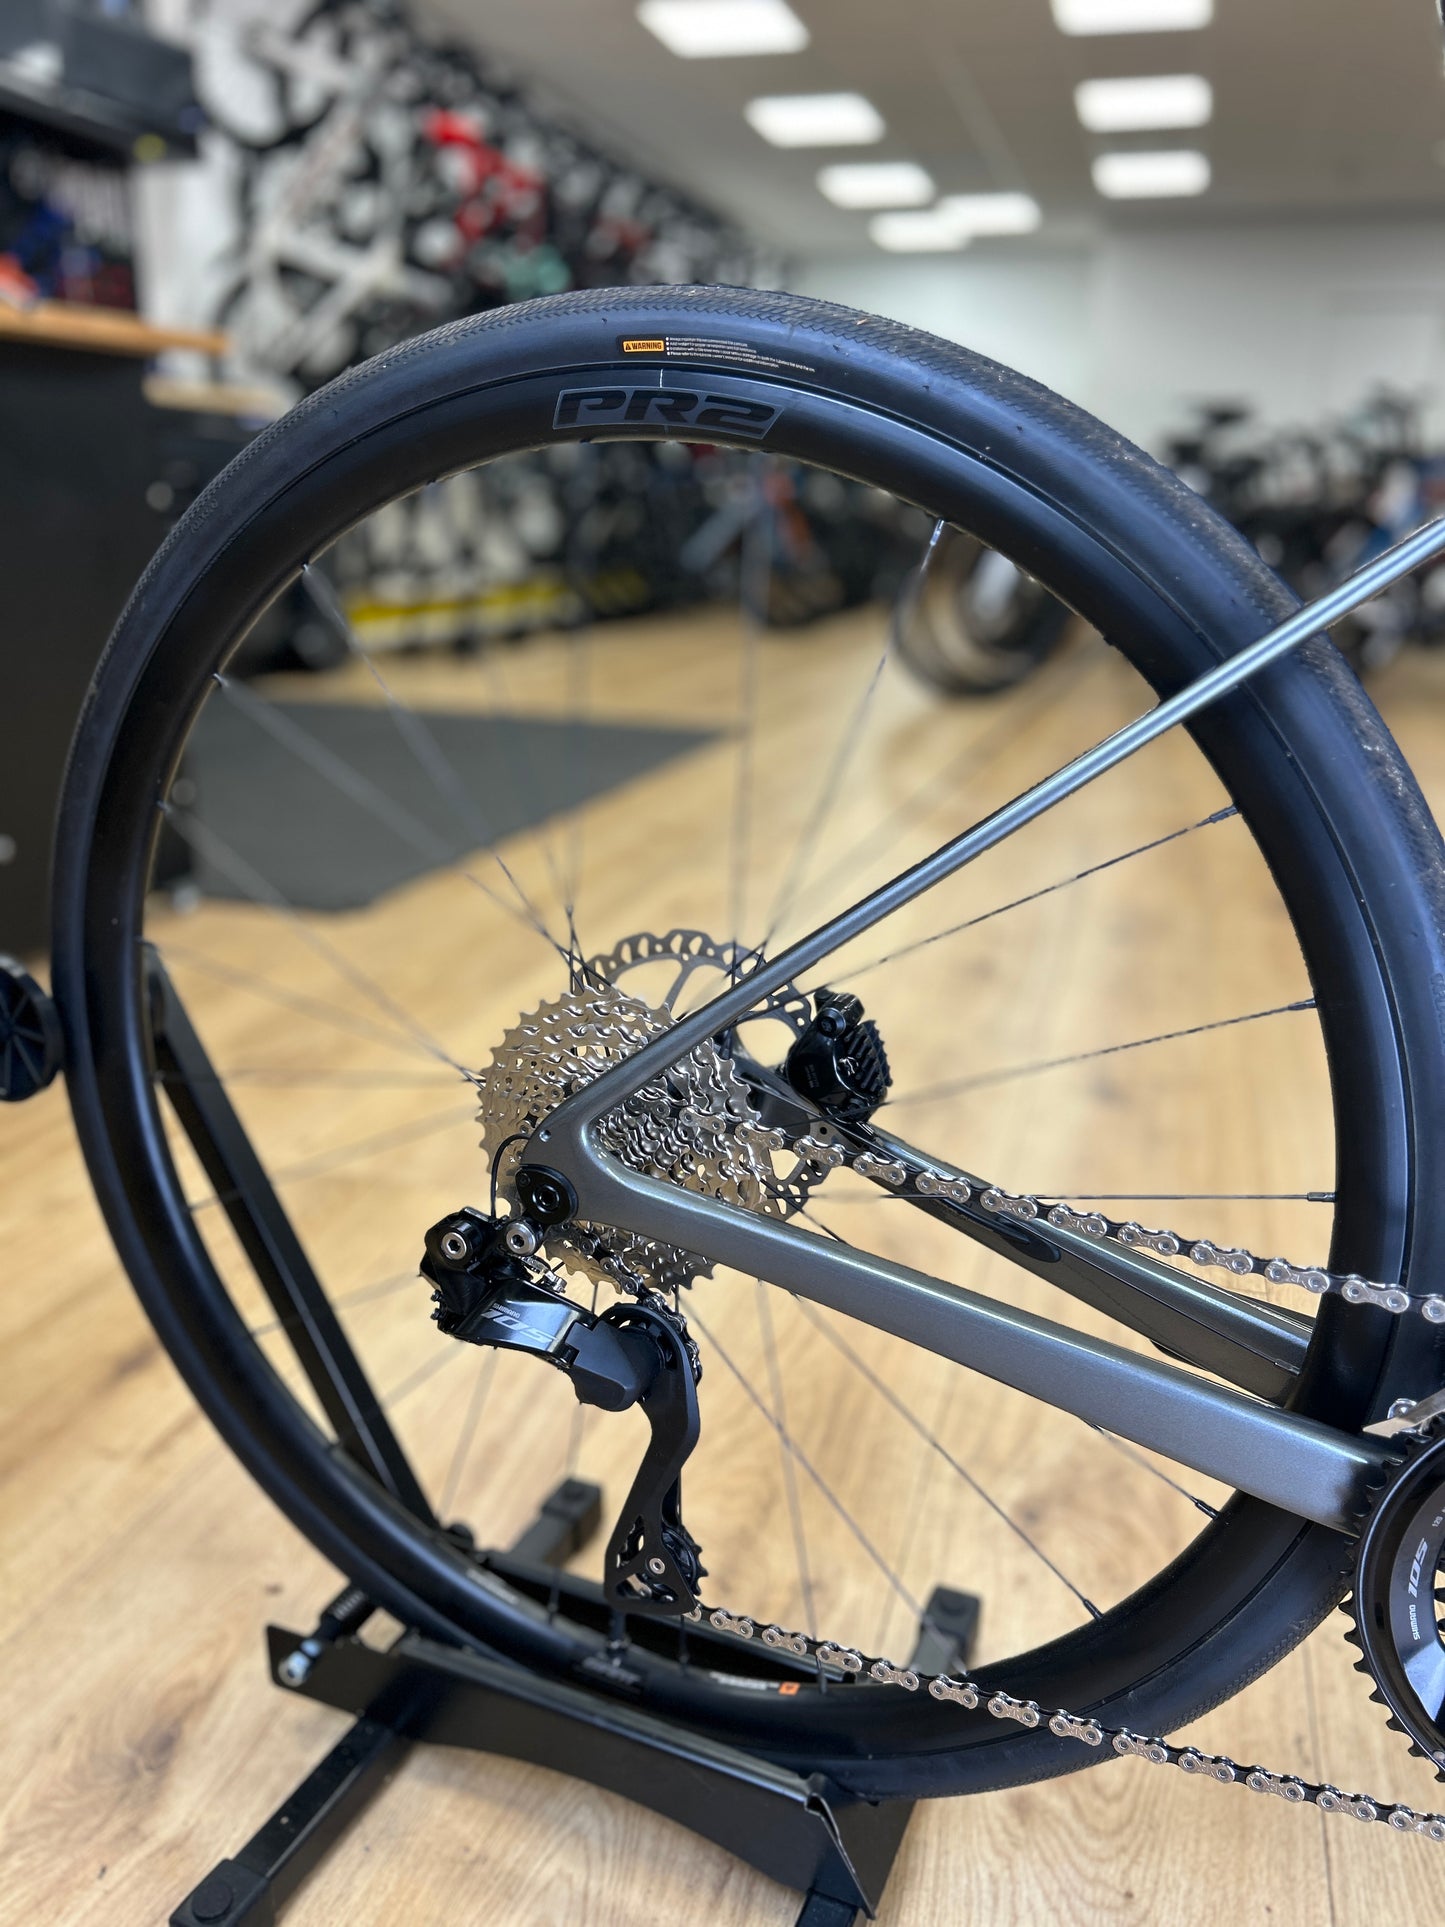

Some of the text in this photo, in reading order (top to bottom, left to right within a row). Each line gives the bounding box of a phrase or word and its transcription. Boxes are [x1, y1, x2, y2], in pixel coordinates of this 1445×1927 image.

[631, 341, 662, 351] WARNING
[556, 389, 777, 436] PR2
[481, 1308, 557, 1344] 105
[492, 1302, 521, 1319] SHIMANO
[1407, 1537, 1428, 1641] SHIMANO 105
